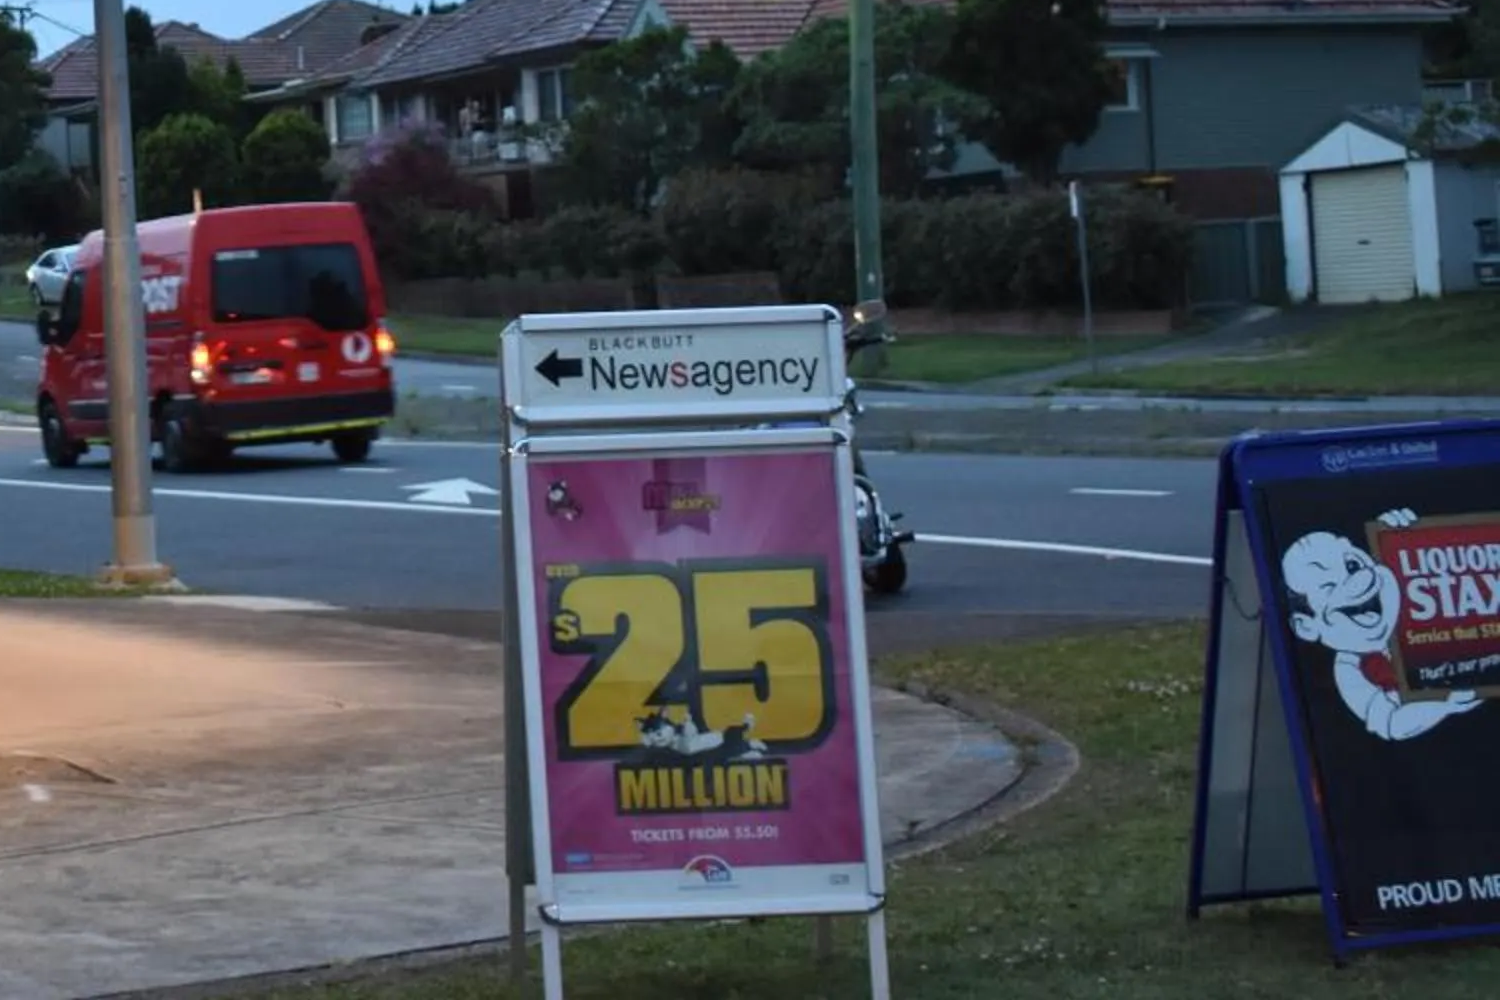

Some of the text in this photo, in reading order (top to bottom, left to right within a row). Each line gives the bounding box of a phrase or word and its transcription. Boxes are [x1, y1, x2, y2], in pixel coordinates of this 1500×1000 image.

[587, 334, 694, 352] BLACKBUTT
[589, 354, 820, 396] Newsagency
[618, 764, 786, 810] MILLION
[630, 828, 684, 843] TICKETS
[688, 826, 730, 841] FROM
[1377, 878, 1463, 910] PROUD
